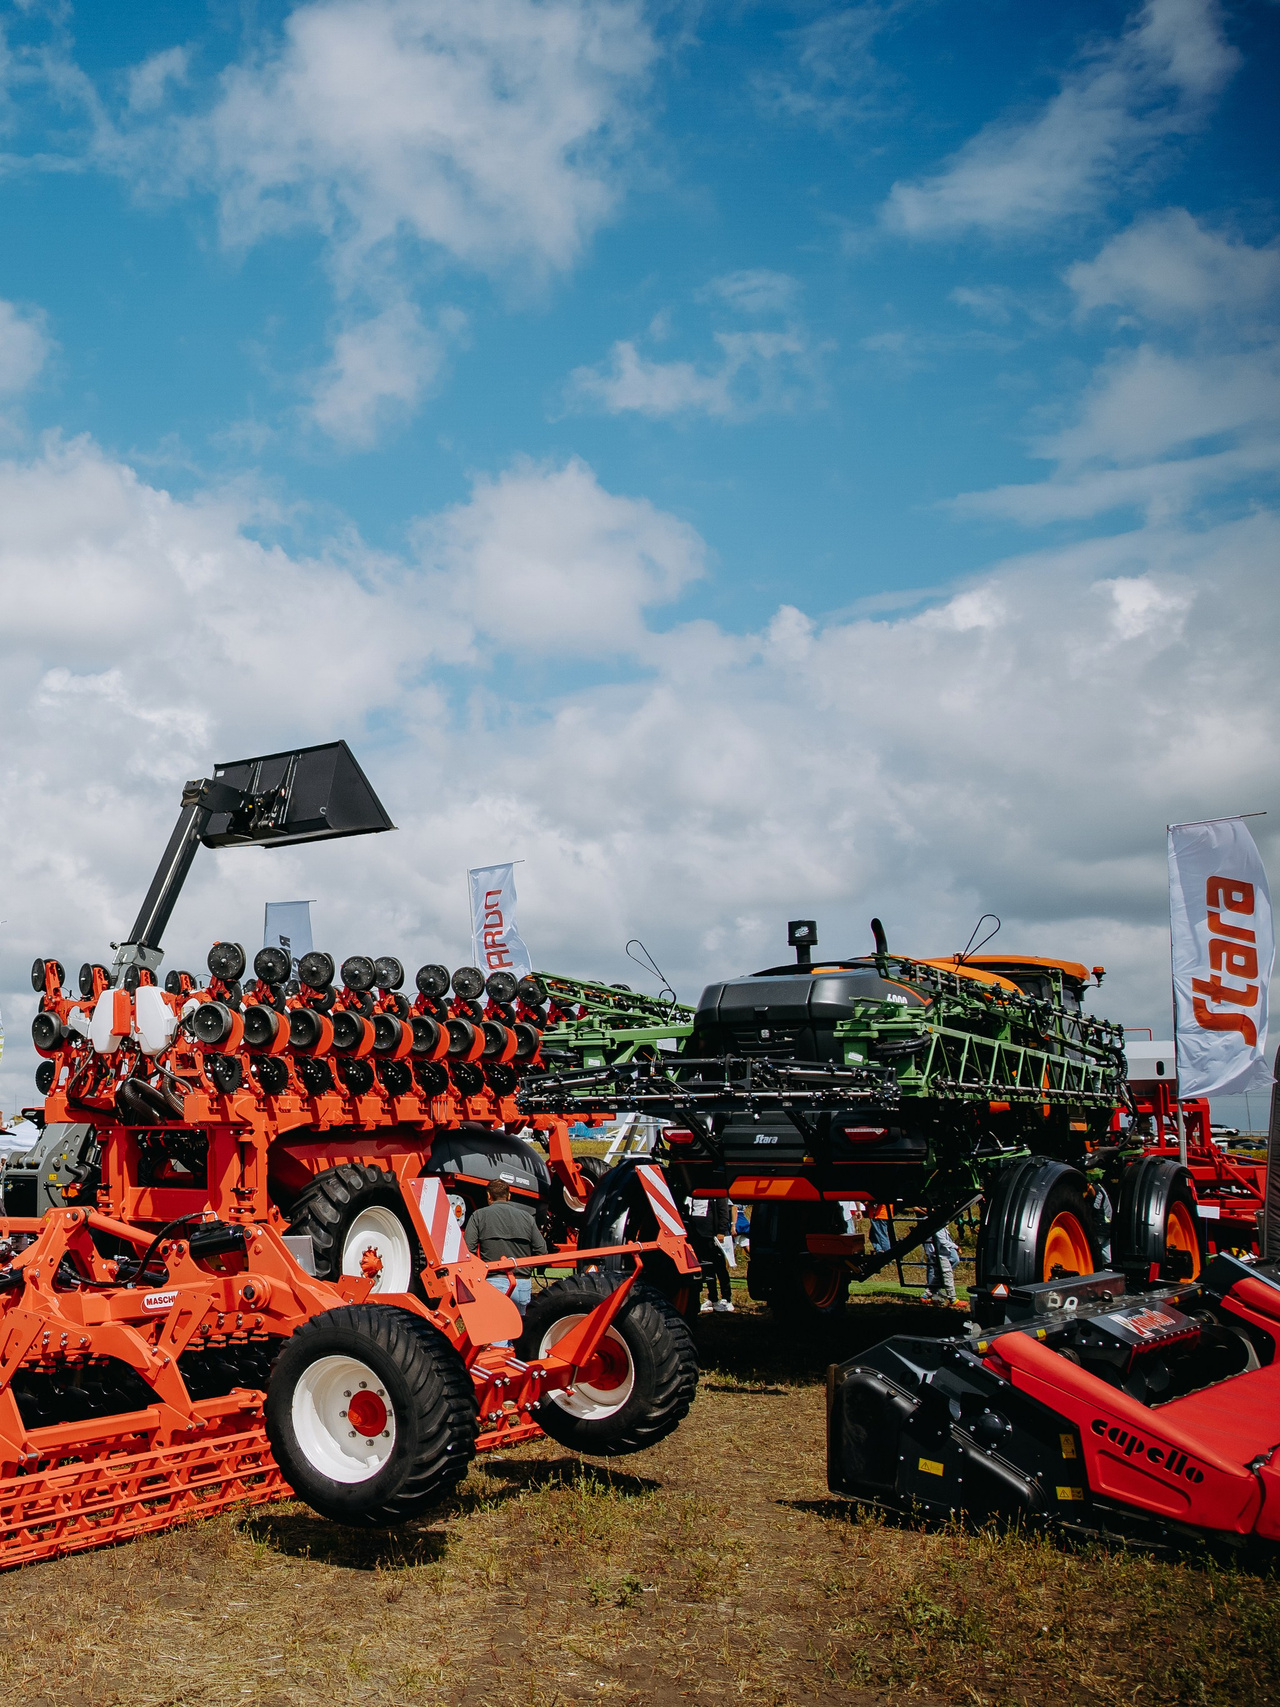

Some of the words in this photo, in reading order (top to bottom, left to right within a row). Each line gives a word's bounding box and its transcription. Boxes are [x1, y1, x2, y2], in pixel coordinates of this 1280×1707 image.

[1192, 875, 1259, 1047] Stara
[753, 1134, 778, 1144] Stara
[1090, 1419, 1204, 1484] capello
